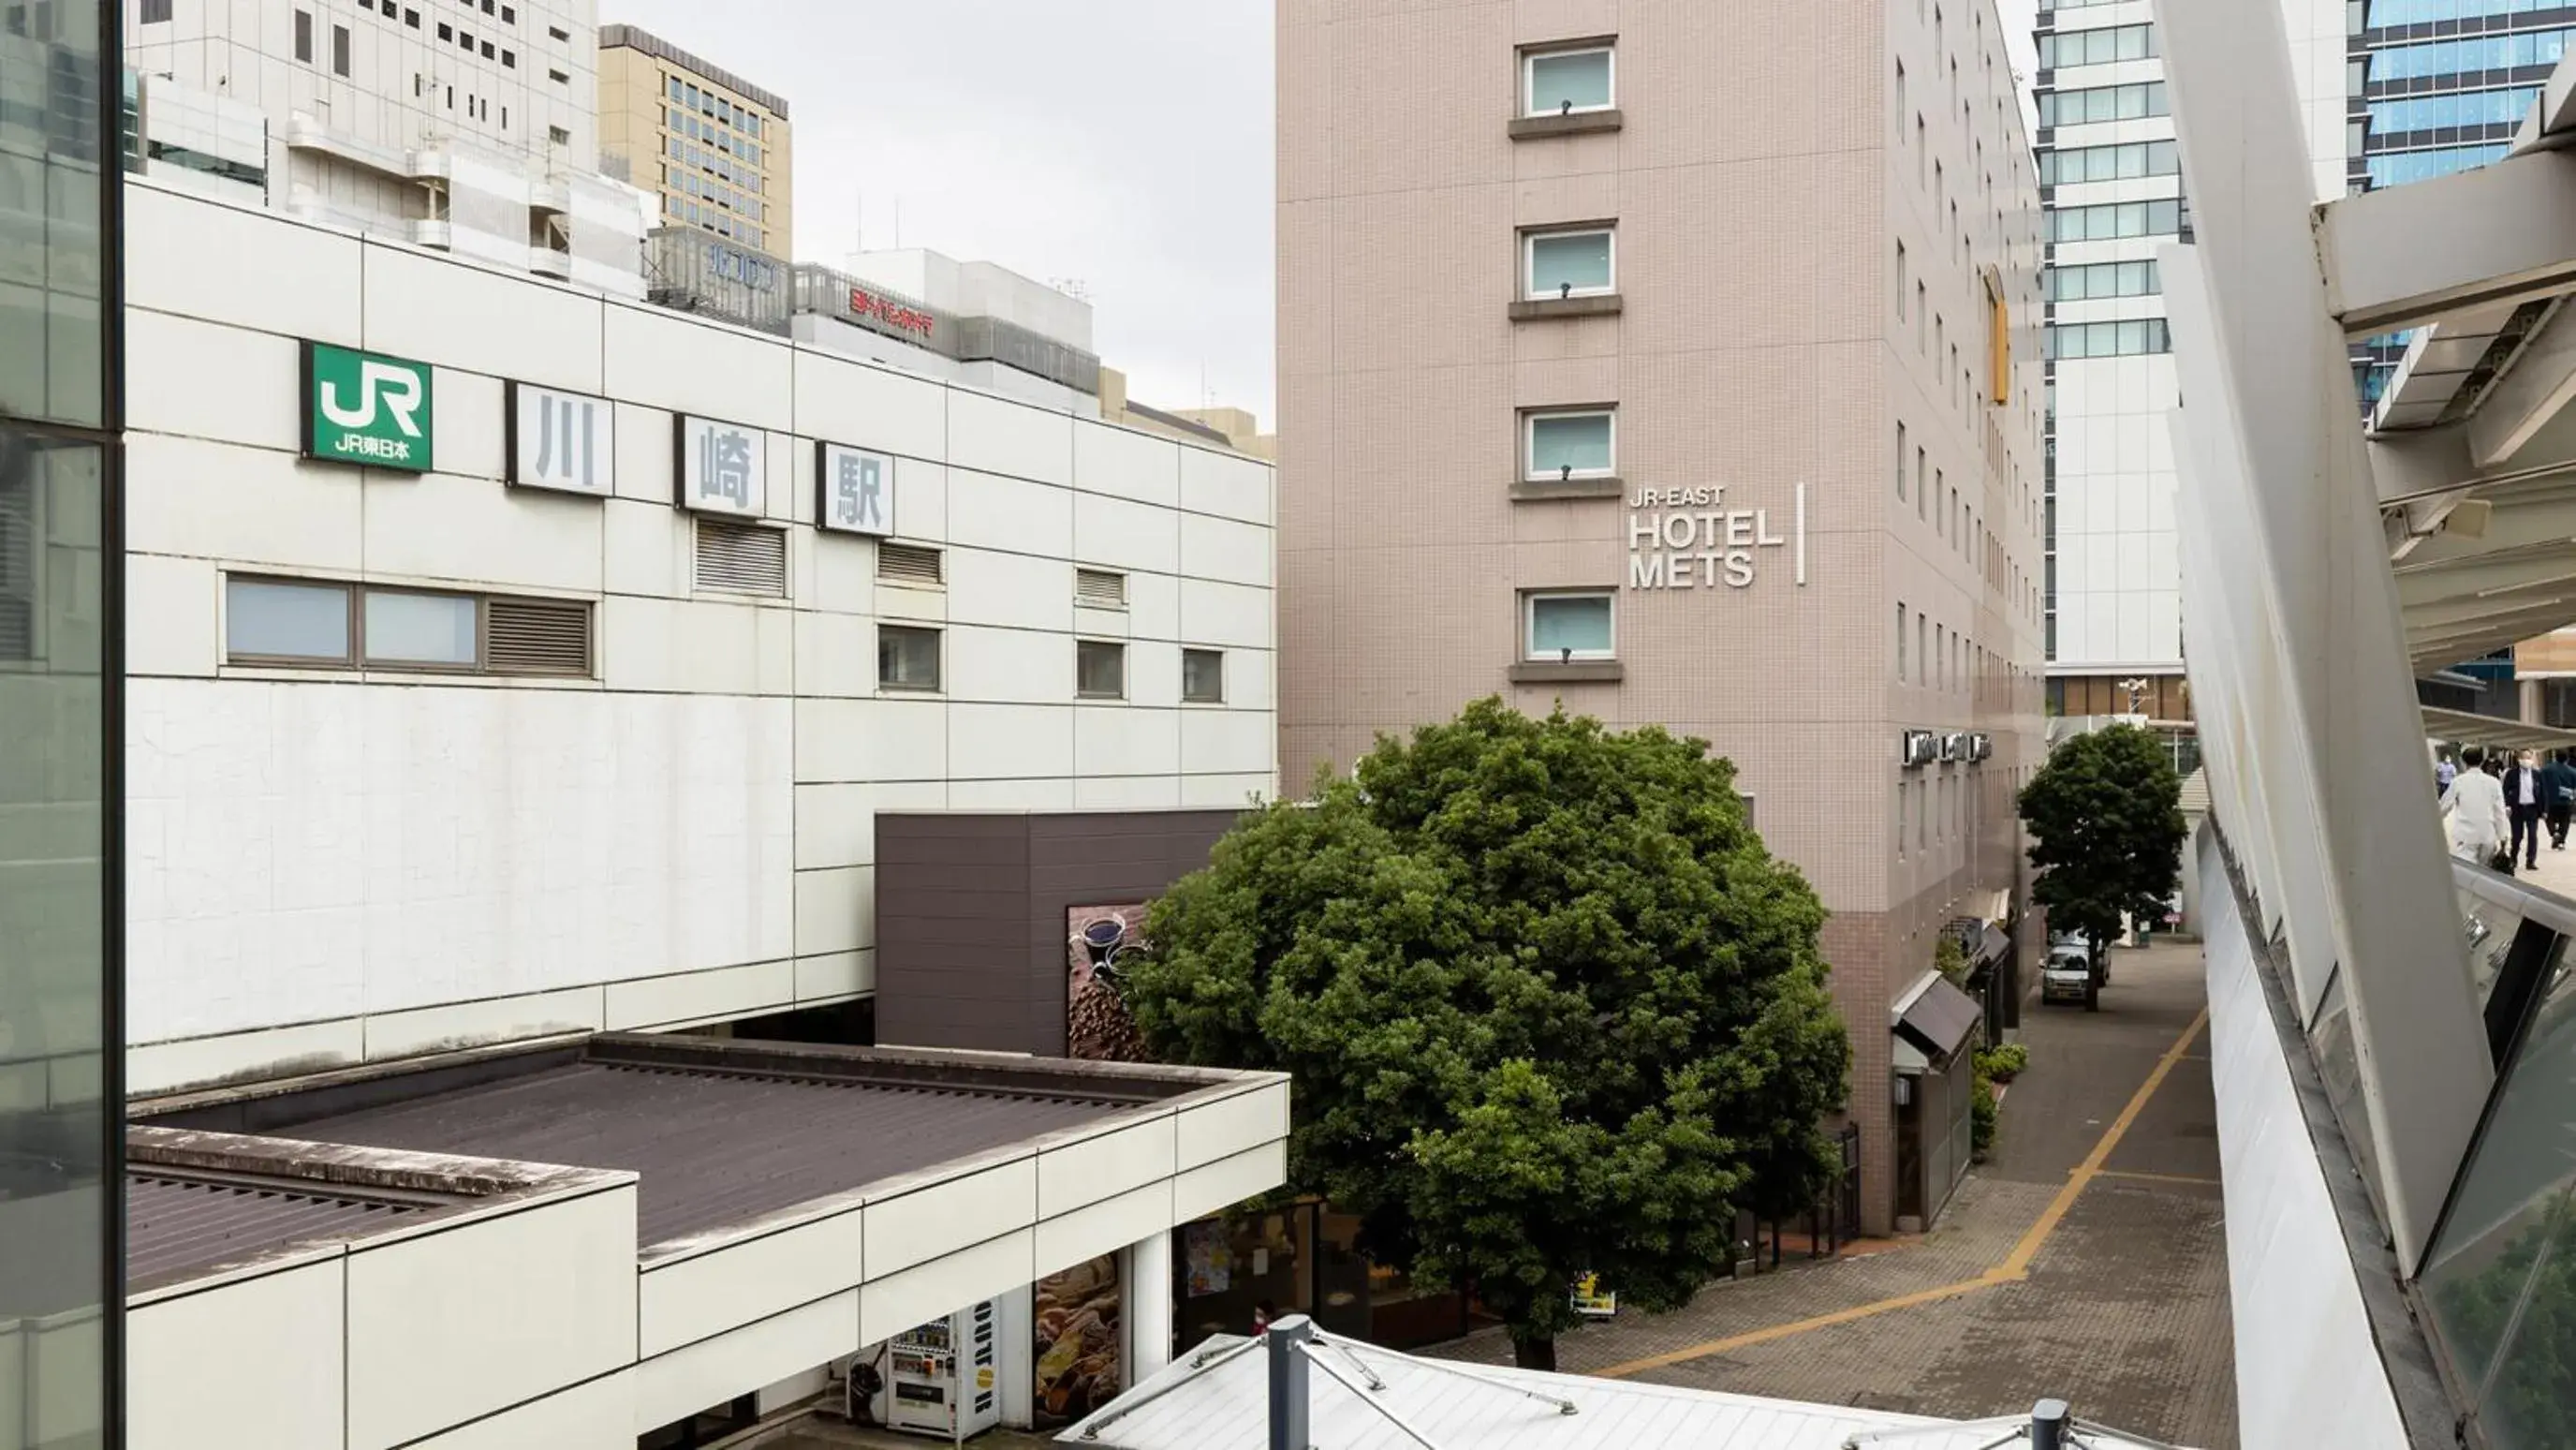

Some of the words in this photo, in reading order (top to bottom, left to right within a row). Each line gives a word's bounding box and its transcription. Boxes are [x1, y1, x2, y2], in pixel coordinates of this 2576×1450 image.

[320, 361, 422, 437] JR
[335, 433, 410, 461] JR東日本
[536, 394, 882, 527] 川崎駅
[1629, 485, 1725, 508] JR-EAST
[1629, 510, 1785, 550] HOTEL
[1629, 551, 1755, 591] METS
[974, 1299, 994, 1414] OUTOR
